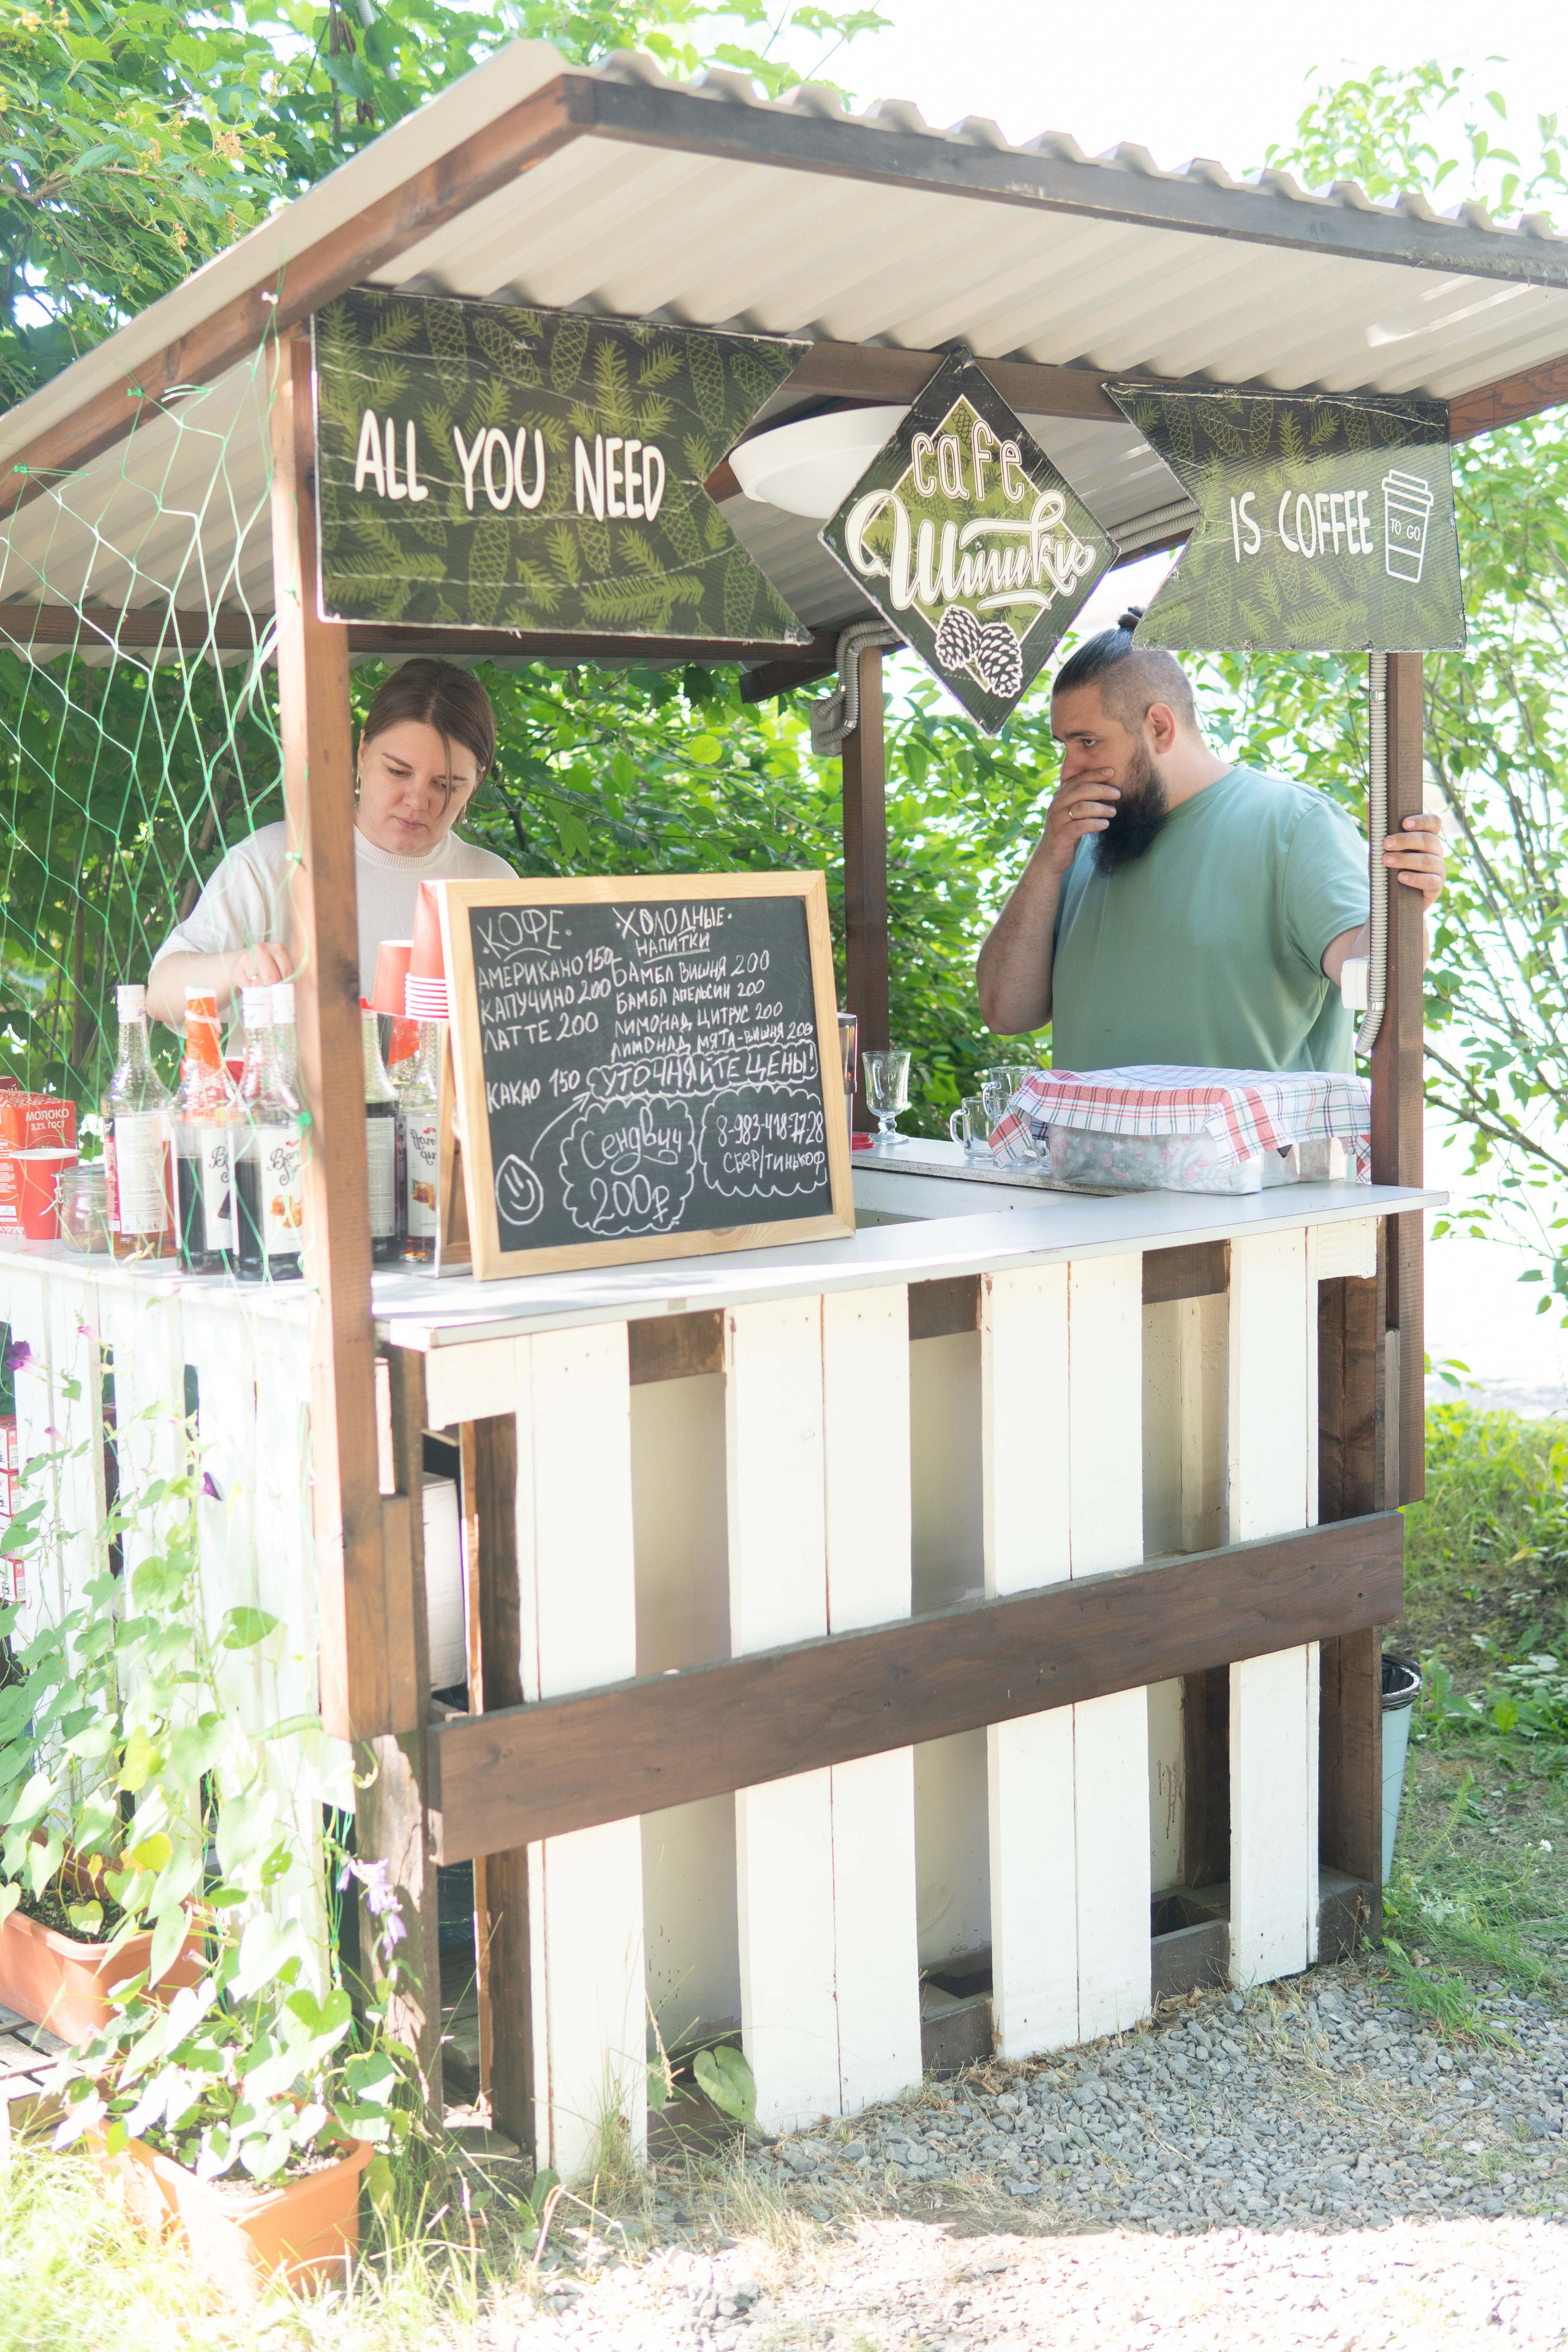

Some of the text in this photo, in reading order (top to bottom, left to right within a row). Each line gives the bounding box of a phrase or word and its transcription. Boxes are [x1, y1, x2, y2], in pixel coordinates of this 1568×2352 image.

[355, 408, 666, 522] ALL YOU NEED
[911, 419, 1026, 503] cafe
[1230, 489, 1374, 564] IS COFFEE
[1389, 517, 1420, 541] TO GO
[635, 932, 710, 957] НАПИТКИ
[478, 946, 613, 994] АМЕРИКАНО 150
[611, 949, 769, 987] БАМБЛ ВИШНЯ 200
[481, 978, 611, 1025] КАПУЧИНО 200
[616, 979, 764, 1014] БАМБЛ АПЕЛЬСИН 200
[484, 1011, 598, 1054] ЛАТТЕ 200
[615, 1001, 782, 1037] ЛИМОНАД ЦИТРУС 200
[611, 1035, 691, 1063] ЛИМОНАД
[786, 1022, 813, 1039] 200
[486, 1068, 580, 1113] КАКАО 150
[601, 1055, 740, 1096] УТОЧНЯЙТЕ
[26, 1108, 69, 1121] МОЛОКО
[31, 1123, 46, 1131] 3,2%
